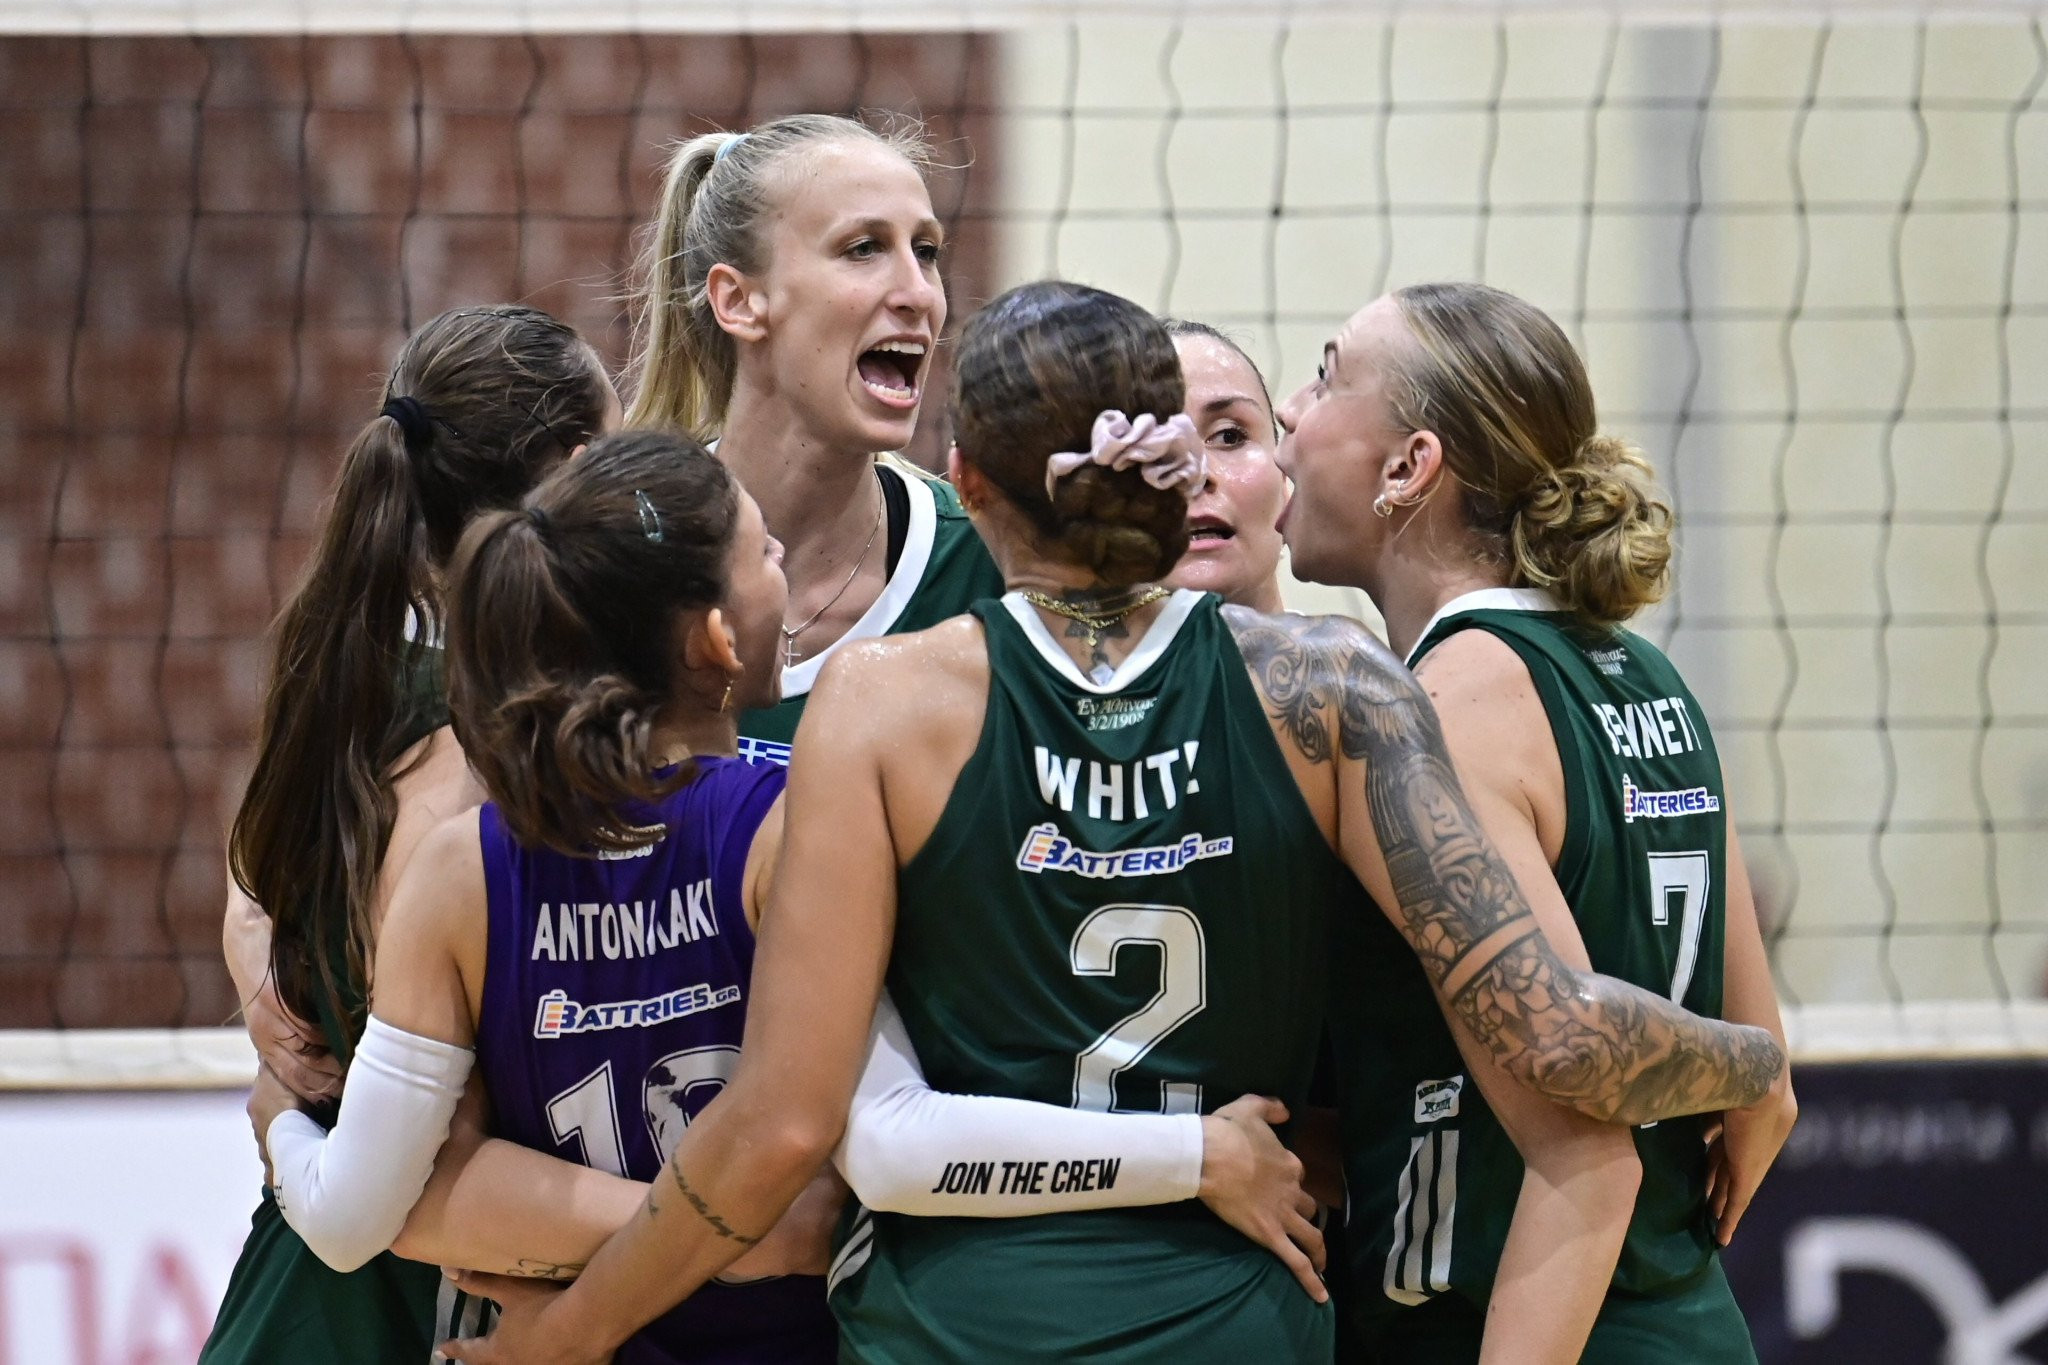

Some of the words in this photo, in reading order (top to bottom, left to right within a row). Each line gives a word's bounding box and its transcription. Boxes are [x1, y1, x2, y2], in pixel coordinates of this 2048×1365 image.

[1646, 850, 1710, 1008] 7
[1069, 903, 1206, 1116] 2
[931, 1162, 995, 1195] JOIN
[999, 1161, 1049, 1195] THE
[1050, 1157, 1122, 1194] CREW
